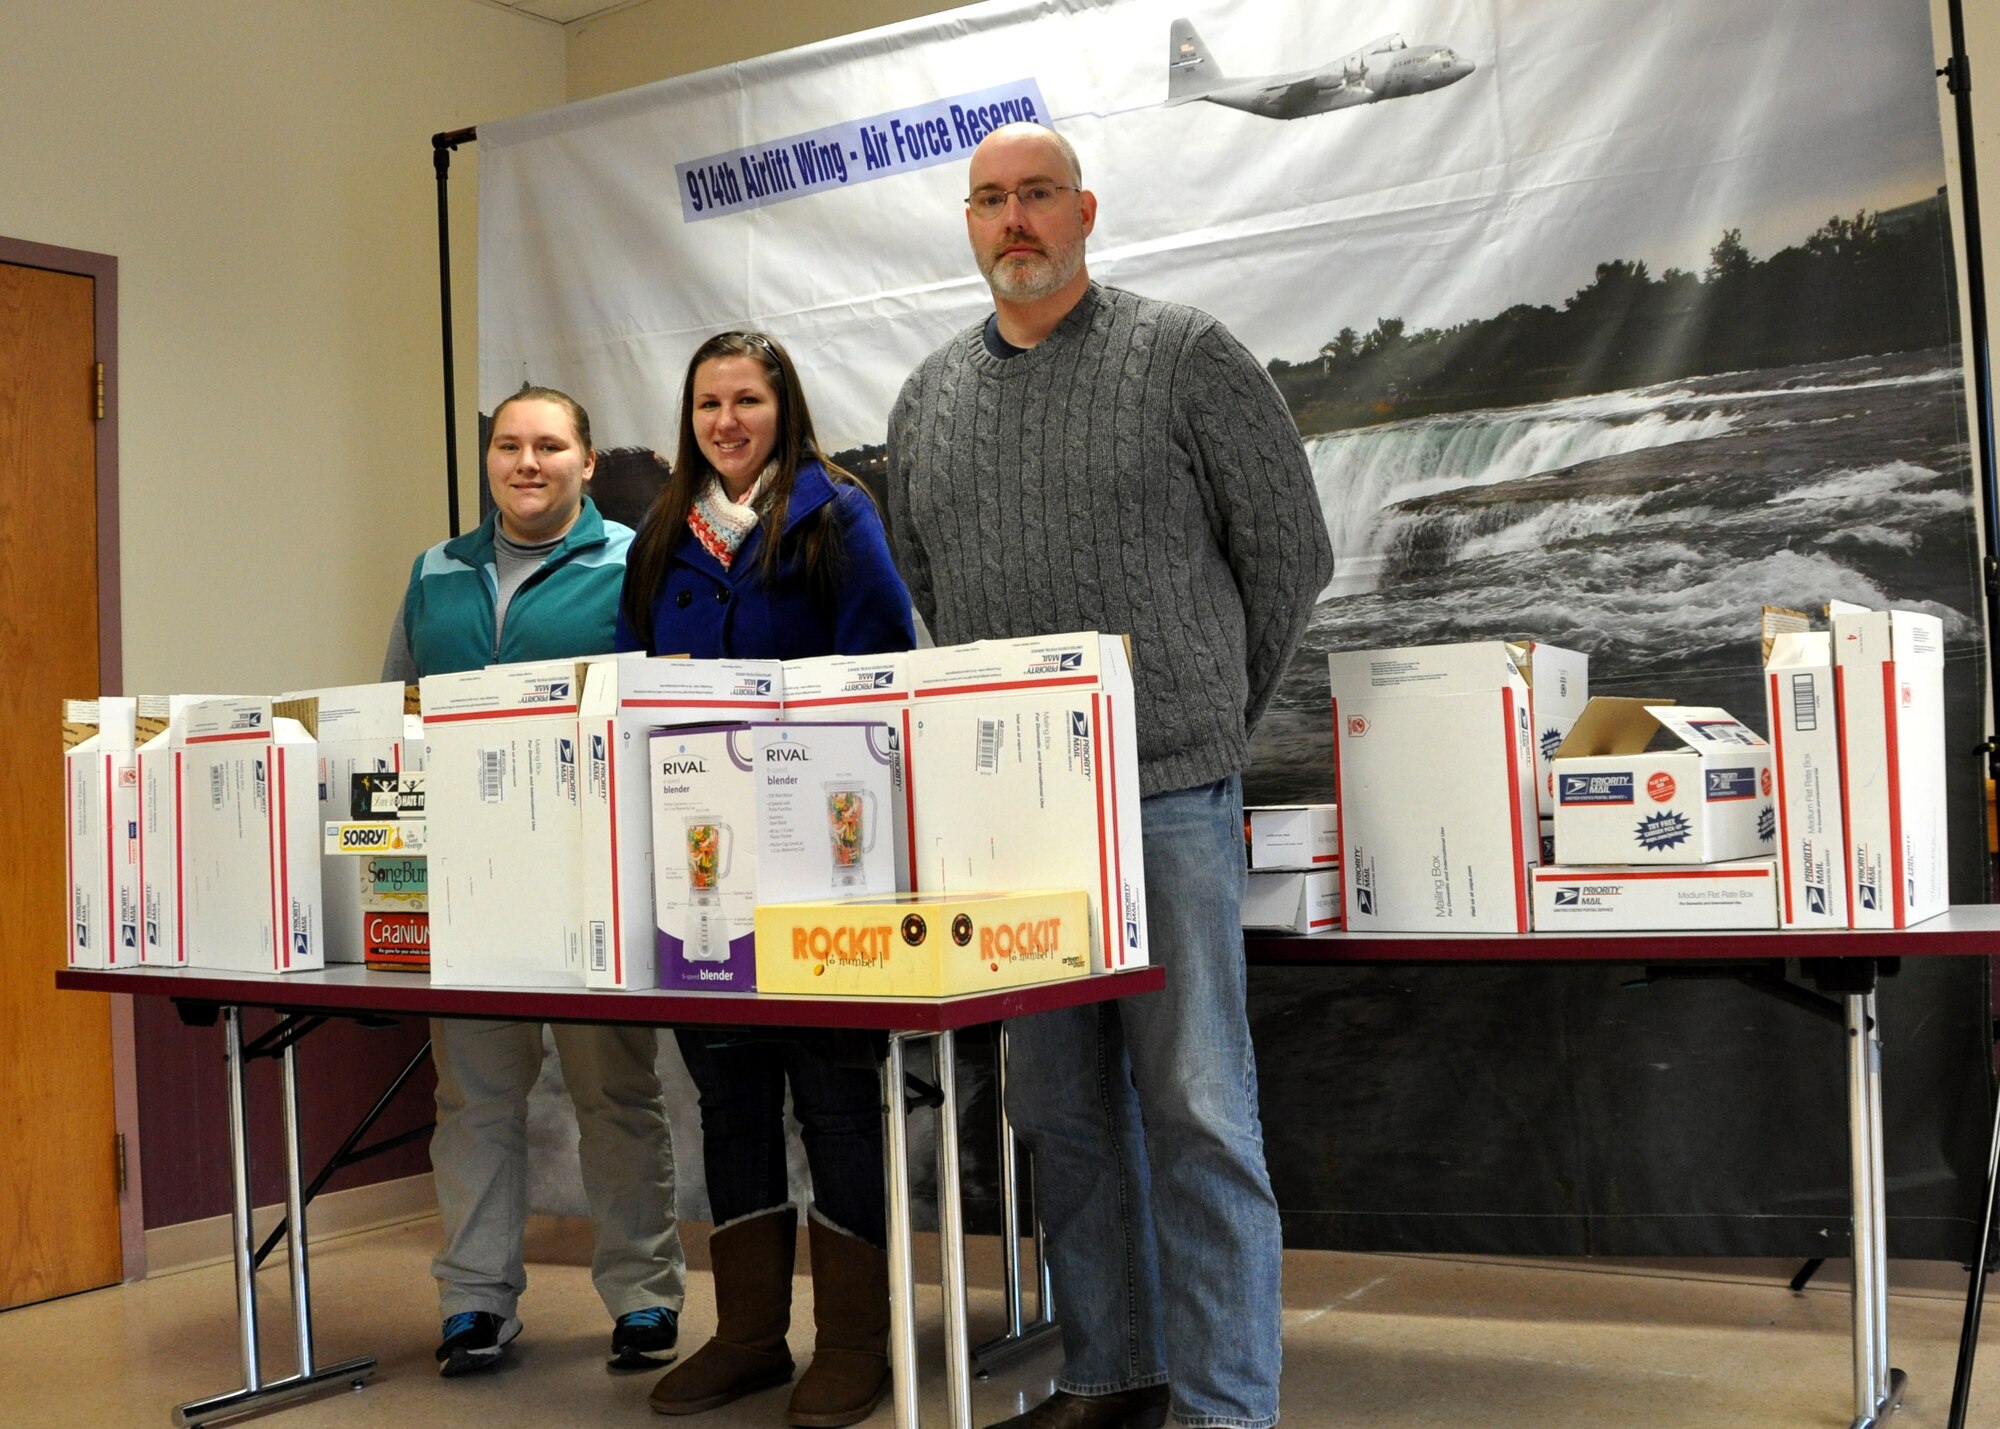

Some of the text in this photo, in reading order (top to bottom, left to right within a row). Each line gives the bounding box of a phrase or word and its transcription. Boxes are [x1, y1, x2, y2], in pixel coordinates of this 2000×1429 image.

[686, 96, 1039, 212] 914th Airlift Wing - Air Force Reserve
[1026, 666, 1058, 674] PRIORITY
[844, 683, 872, 691] PRIORITY
[521, 695, 548, 703] PRIORITY
[766, 749, 809, 761] RIVAL
[1083, 739, 1091, 778] PRIORITY
[1803, 753, 1811, 768] Box
[663, 761, 706, 775] RIVAL
[767, 775, 798, 785] blender
[1591, 777, 1629, 785] PRIORITY
[1804, 769, 1812, 787] Rate
[664, 785, 690, 794] blender
[1589, 785, 1611, 793] MAIL
[402, 795, 417, 806] HATE
[1648, 818, 1675, 830] TRY FREE
[343, 829, 387, 845] SORRY!
[1803, 841, 1813, 883] PRIORITY
[1857, 847, 1865, 883] PRIORITY
[1816, 862, 1824, 885] MAIL
[1432, 856, 1445, 917] Mailing Box
[1583, 886, 1620, 894] PRIORITY
[1678, 891, 1706, 899] Medium
[1721, 890, 1738, 898] Rate
[1739, 890, 1754, 898] Box
[292, 900, 300, 931] PRIORITY
[792, 926, 893, 960] ROCKIT
[980, 918, 1061, 961] ROCKIT
[839, 951, 877, 968] number
[700, 969, 733, 980] blender
